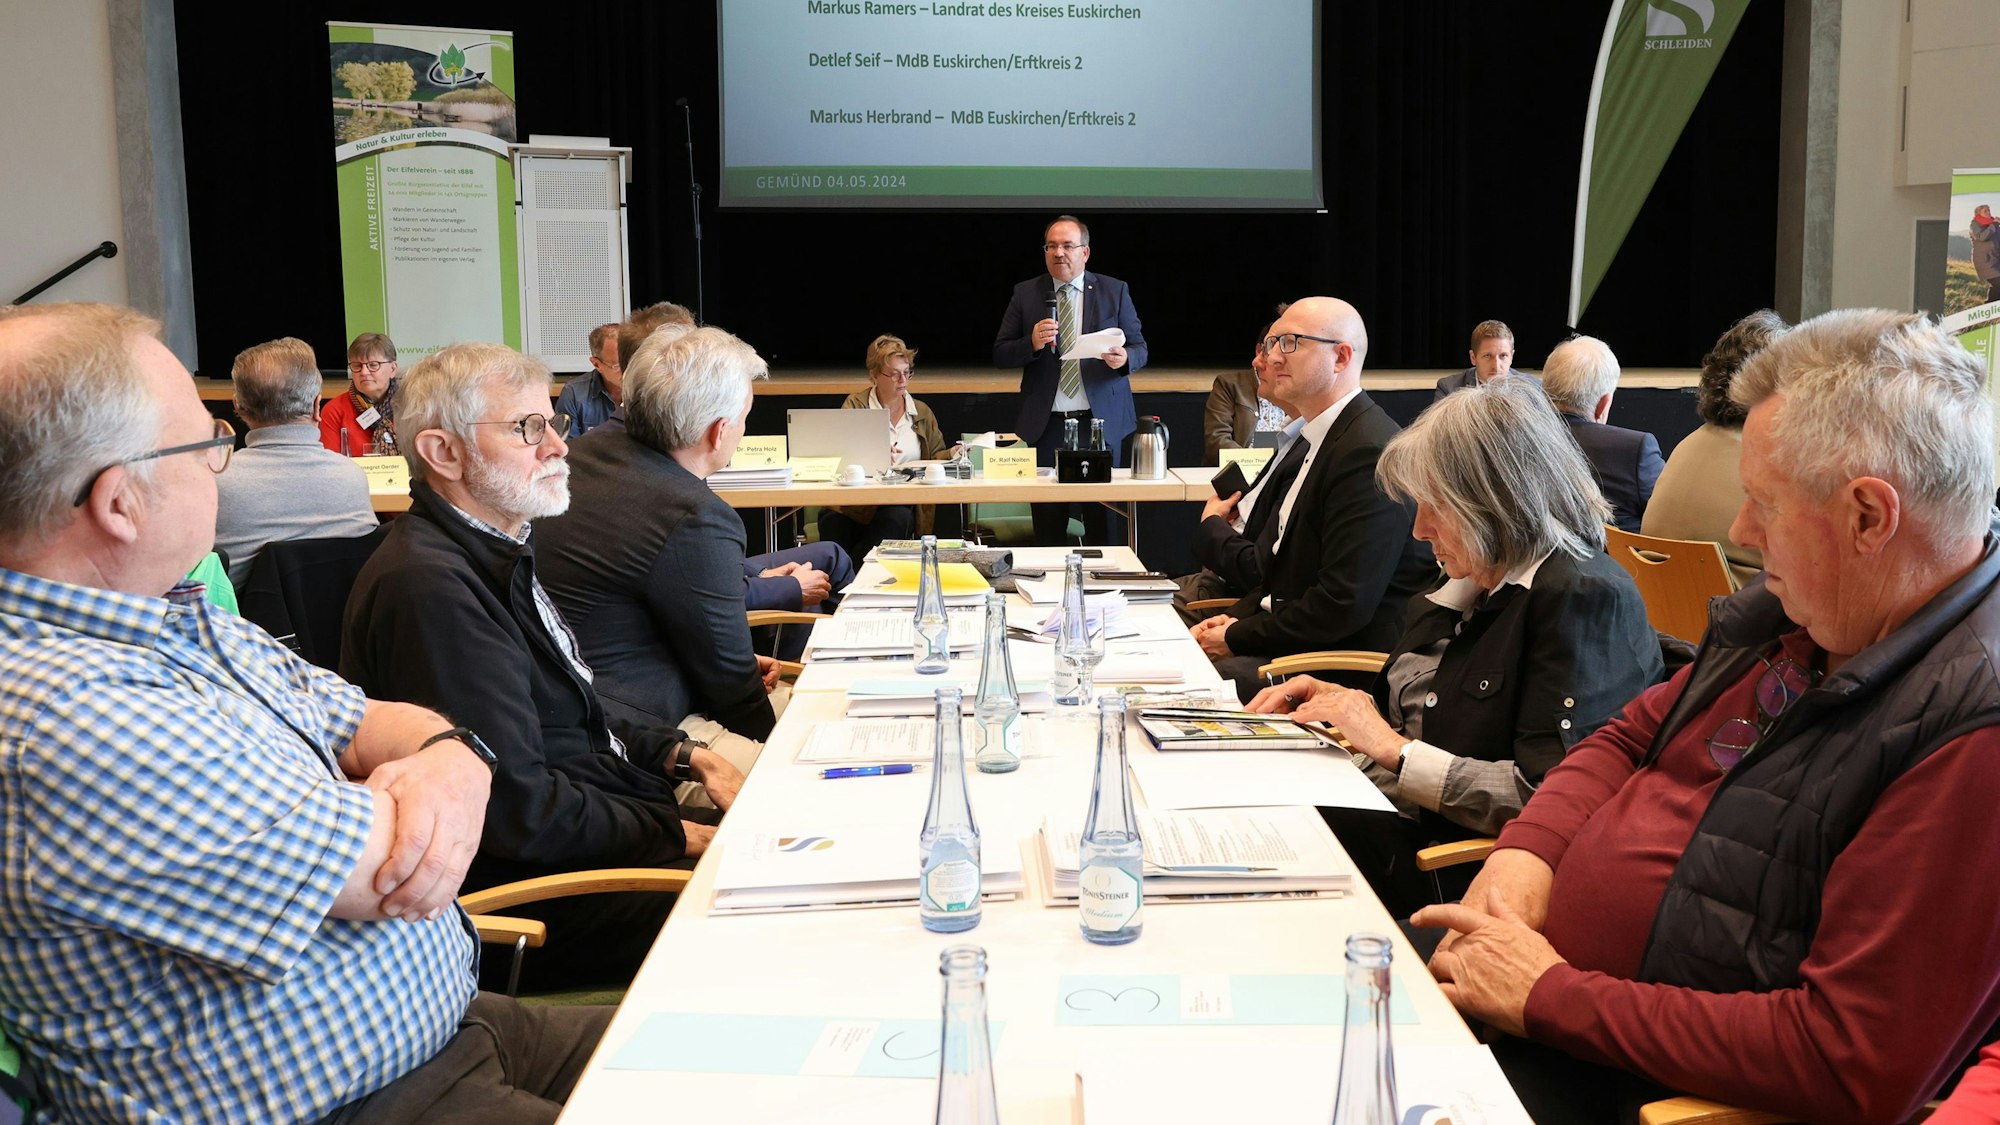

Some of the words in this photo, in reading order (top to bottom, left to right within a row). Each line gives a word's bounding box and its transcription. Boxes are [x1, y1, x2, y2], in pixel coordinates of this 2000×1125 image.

[808, 0, 860, 15] Markus
[864, 2, 916, 15] Ramers
[932, 2, 984, 16] Landrat
[988, 2, 1012, 16] des
[1016, 4, 1064, 18] Kreises
[1068, 4, 1141, 18] Euskirchen
[1644, 38, 1712, 50] SCHLEIDEN
[809, 52, 851, 67] Detlef
[854, 52, 880, 67] Seif
[896, 54, 929, 68] MdB
[934, 54, 1070, 71] Euskirchen/Erftkreis
[1074, 56, 1082, 70] 2
[810, 109, 862, 124] Markus
[866, 109, 932, 124] Herbrand
[952, 110, 984, 124] MdB
[988, 110, 1124, 127] Euskirchen/Erftkreis
[1128, 112, 1136, 126] 2
[355, 140, 378, 150] Natur
[390, 132, 415, 142] Kultur
[366, 165, 376, 210] FREIZEIT
[756, 173, 822, 188] GEMÜND
[827, 176, 906, 188] 04.05.2024
[368, 214, 378, 250] AKTIVE
[1968, 305, 2000, 322] Mitglie
[397, 344, 441, 354] www.eif
